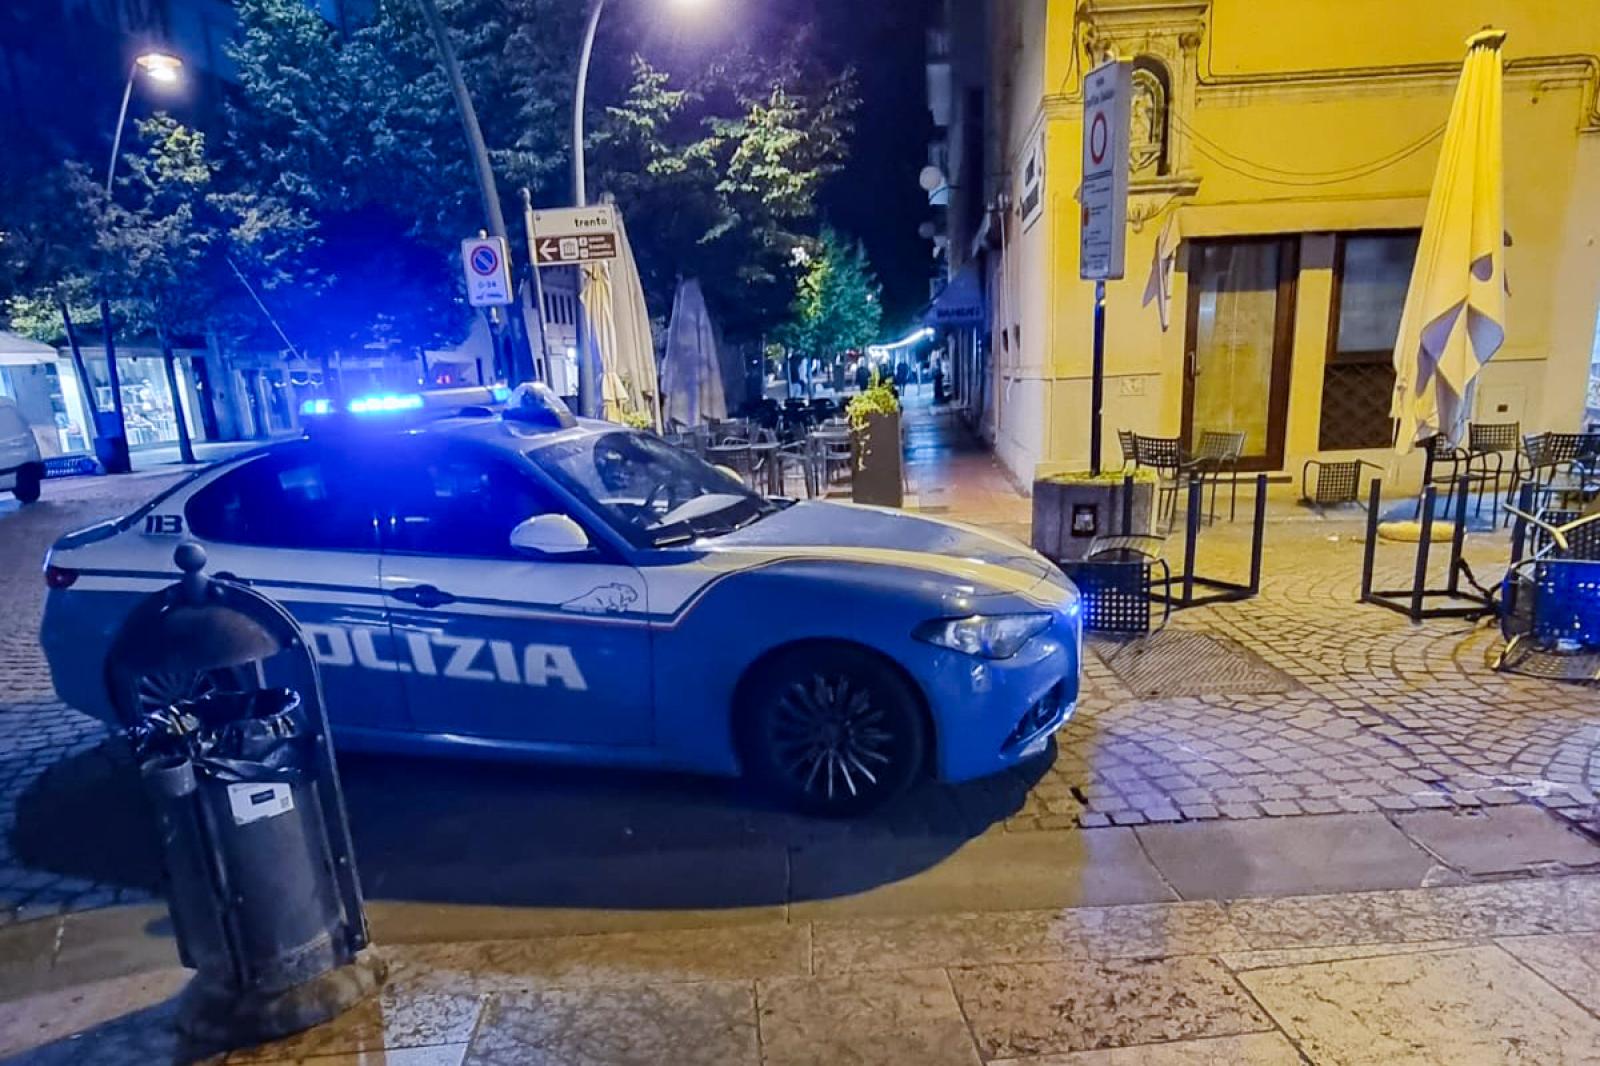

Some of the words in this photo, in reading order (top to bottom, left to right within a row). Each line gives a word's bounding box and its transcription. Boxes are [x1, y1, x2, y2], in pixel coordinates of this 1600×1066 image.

[574, 216, 608, 228] trento
[145, 514, 183, 534] 113
[300, 622, 588, 690] OLIZIA
